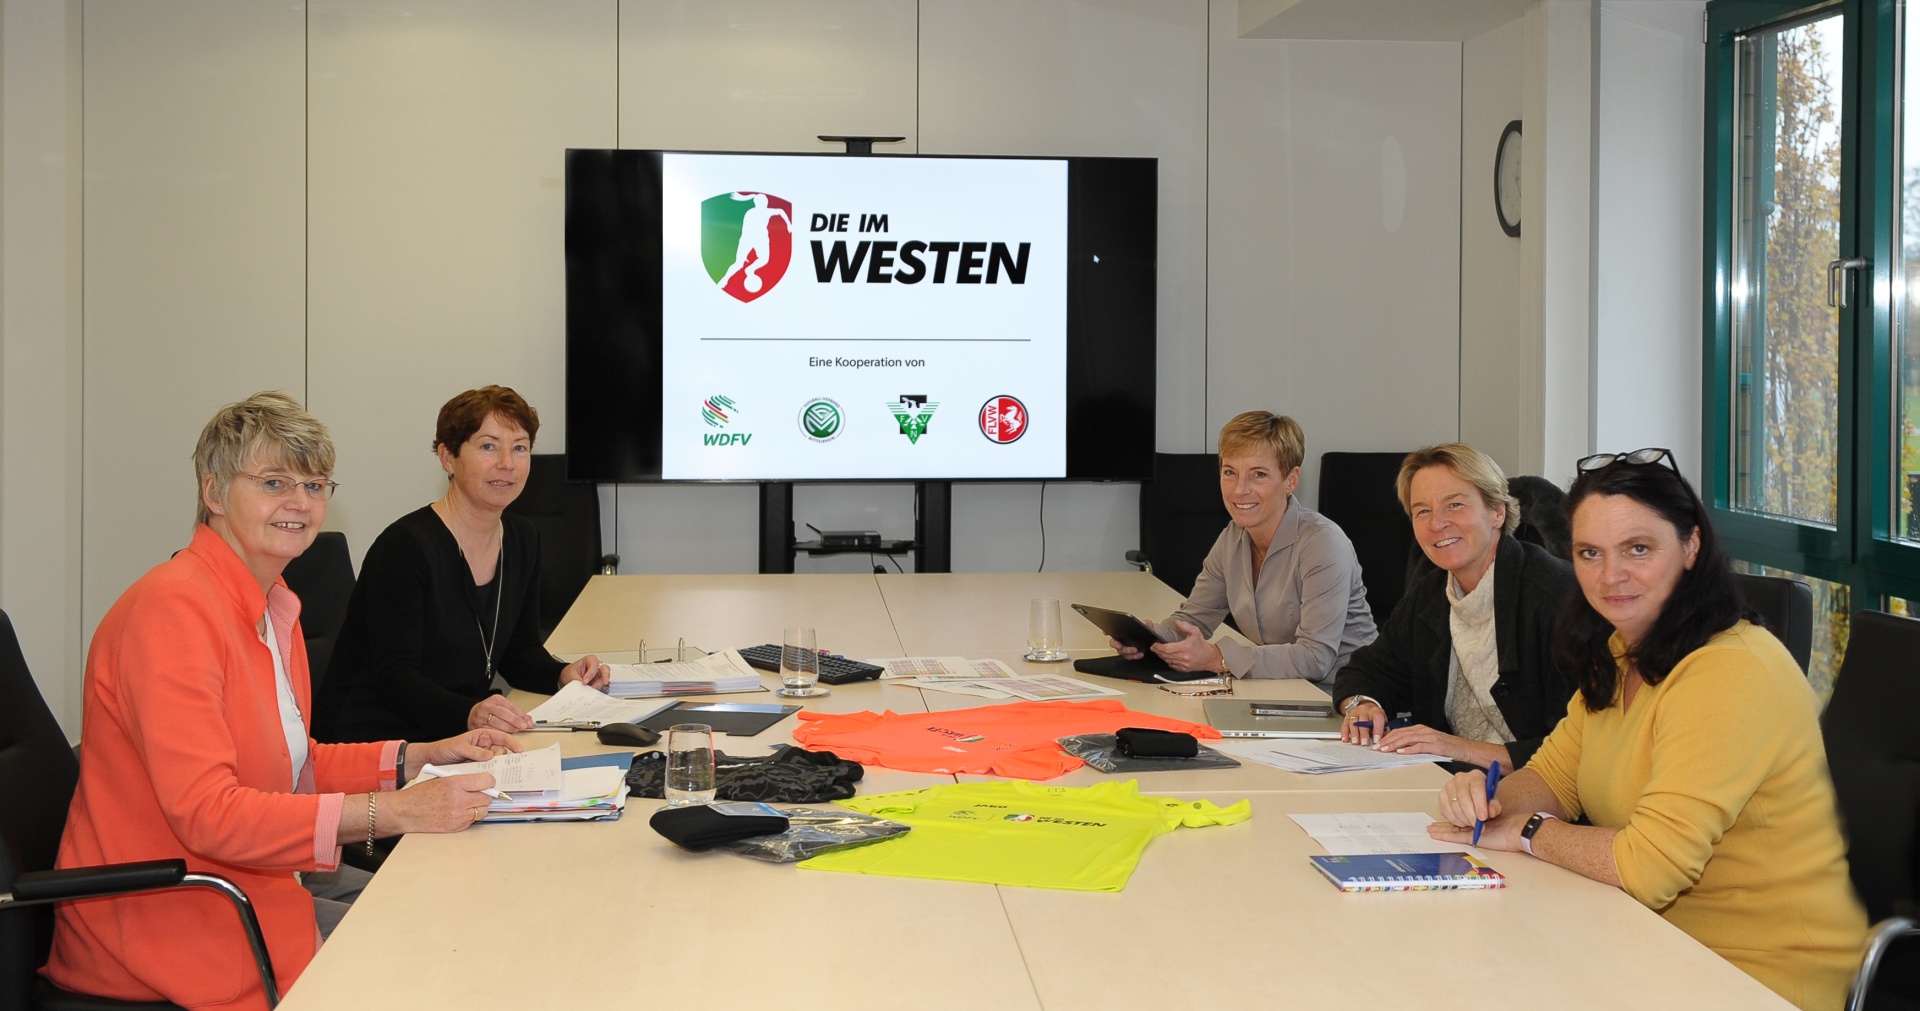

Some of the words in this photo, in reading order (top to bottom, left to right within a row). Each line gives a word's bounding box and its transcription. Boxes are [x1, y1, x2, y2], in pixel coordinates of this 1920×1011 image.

[810, 213, 850, 233] DIE
[858, 213, 889, 233] IM
[810, 239, 1031, 285] WESTEN
[809, 356, 832, 368] Eine
[834, 356, 902, 370] Kooperation
[904, 358, 925, 368] von
[987, 405, 998, 435] FLVW
[703, 433, 753, 446] WDFV
[1036, 819, 1108, 828] WESTEN
